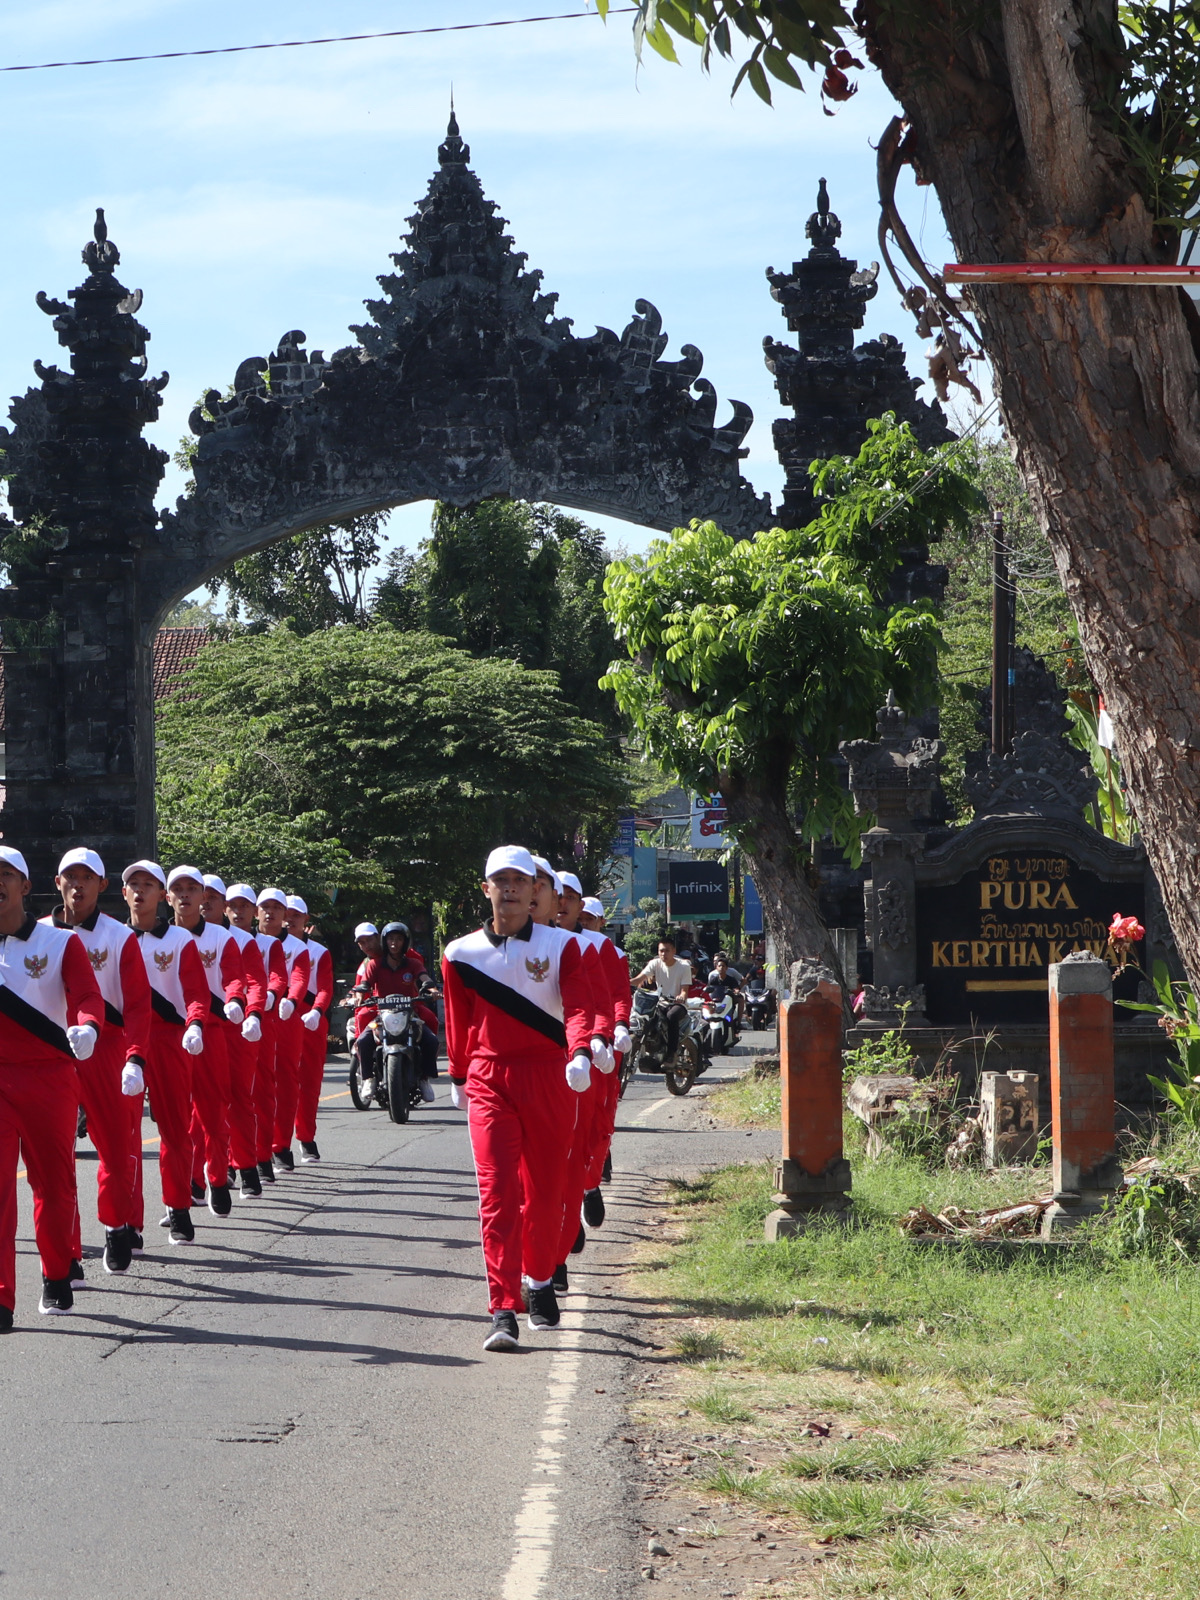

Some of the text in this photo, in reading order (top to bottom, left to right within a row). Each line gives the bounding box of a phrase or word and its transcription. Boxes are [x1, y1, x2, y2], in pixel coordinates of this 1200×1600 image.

[675, 881, 723, 894] Infinix
[979, 881, 1079, 910] PURA
[931, 940, 1044, 967] KERTHA
